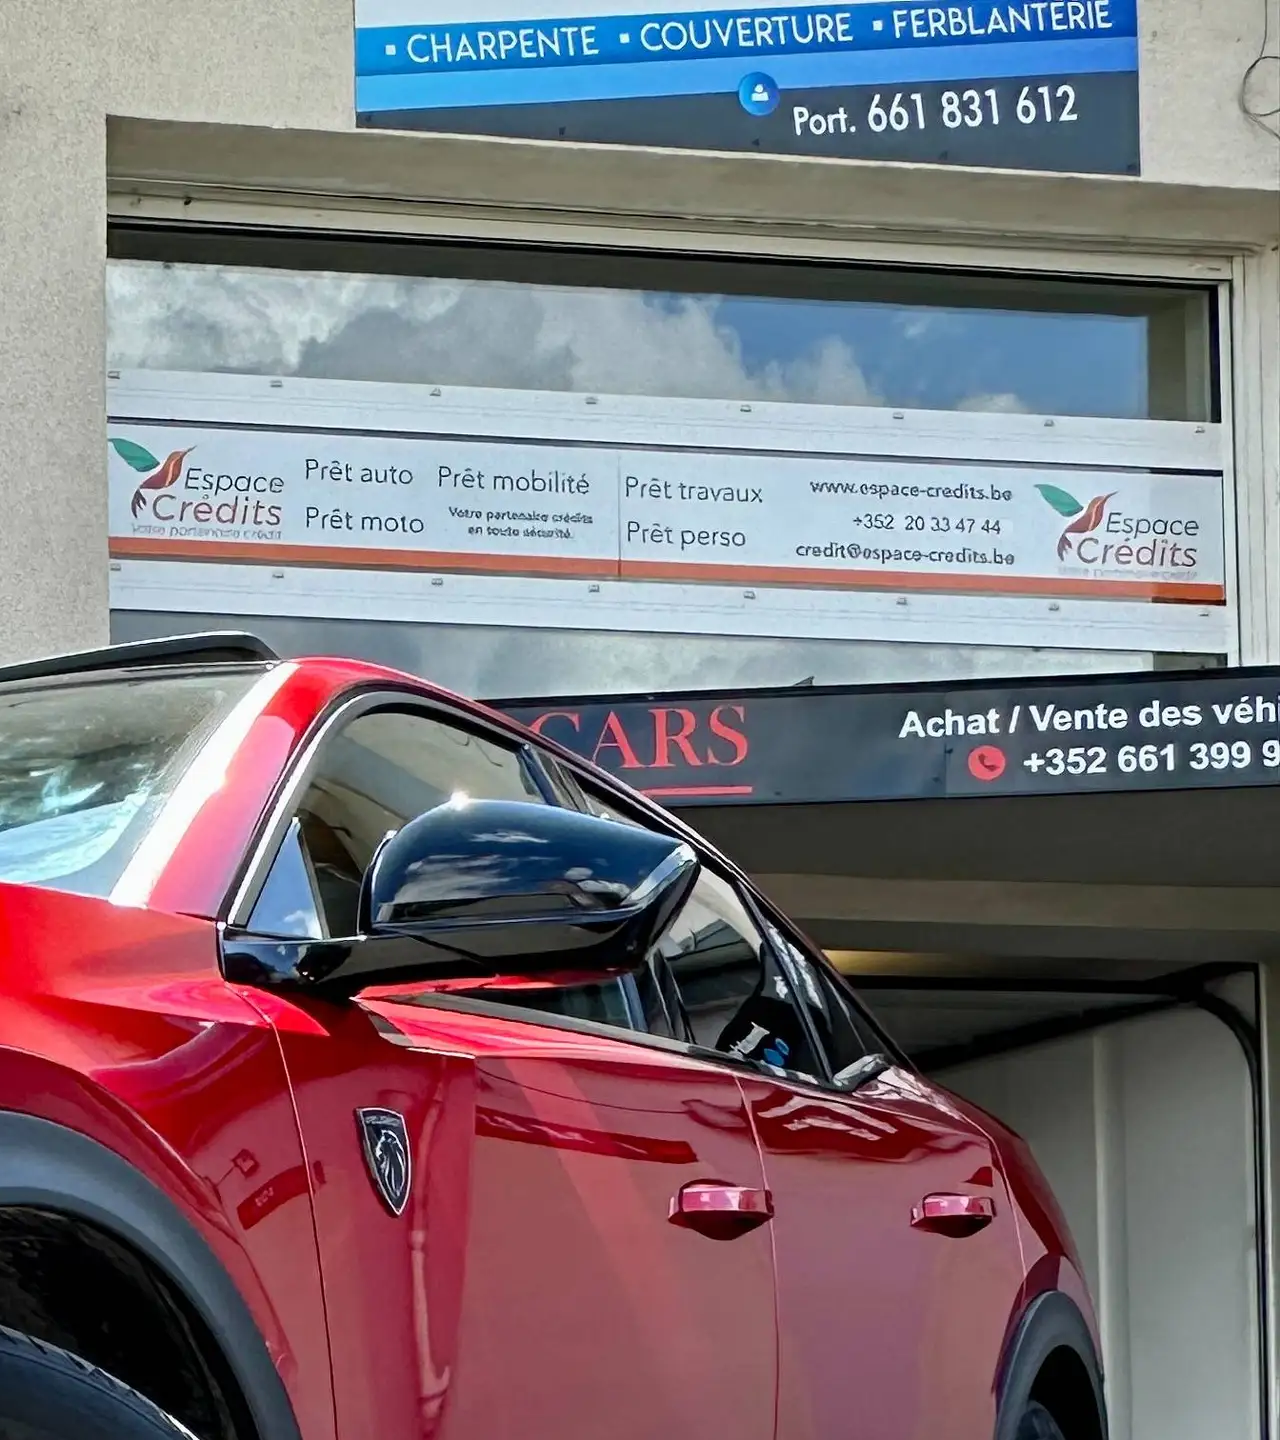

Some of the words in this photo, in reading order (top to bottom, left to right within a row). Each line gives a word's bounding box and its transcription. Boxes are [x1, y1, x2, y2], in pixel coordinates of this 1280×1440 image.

[407, 25, 600, 63] CHARPENTE
[640, 12, 854, 52] COUVERTURE
[892, 0, 1114, 39] FERBLANTERIE
[793, 105, 856, 136] Port.
[868, 92, 926, 133] 661
[941, 88, 1000, 129] 831
[1016, 84, 1079, 124] 612
[184, 467, 285, 496] Espace
[305, 458, 353, 482] Prêt
[360, 465, 414, 485] auto
[438, 465, 486, 489] Prêt
[493, 469, 591, 495] mobilité
[625, 476, 673, 500] Prêt
[678, 482, 764, 504] travaux
[809, 480, 1013, 502] www.espace-credits.be
[151, 494, 282, 526] Crédits
[306, 506, 354, 531] Prêt
[361, 515, 425, 534] moto
[852, 513, 895, 531] +352
[904, 515, 926, 532] 20
[930, 517, 951, 533] 33
[955, 518, 976, 534] 47
[981, 519, 1002, 536] 44
[627, 521, 675, 545] Prêt
[681, 530, 746, 551] perso
[1105, 512, 1200, 539] Espace
[795, 541, 1016, 566] credit@espace-credits.be
[1076, 536, 1198, 568] Crédits
[898, 708, 1001, 739] Achat
[1008, 704, 1021, 735] /
[1028, 703, 1129, 732] Vente
[1139, 700, 1203, 728] des
[1023, 746, 1108, 776] +352
[1117, 743, 1176, 773] 661
[1189, 740, 1252, 771] 399
